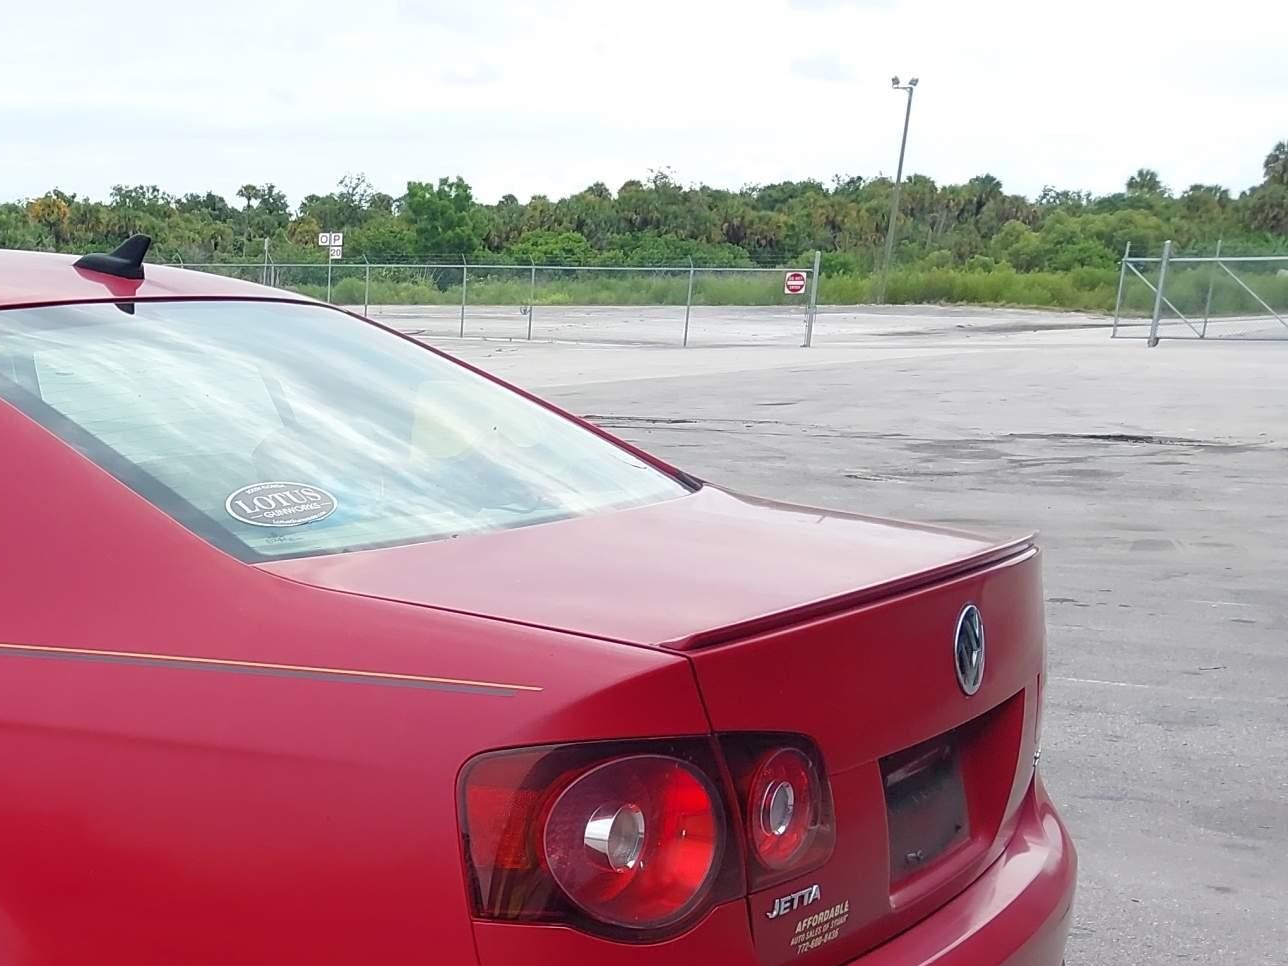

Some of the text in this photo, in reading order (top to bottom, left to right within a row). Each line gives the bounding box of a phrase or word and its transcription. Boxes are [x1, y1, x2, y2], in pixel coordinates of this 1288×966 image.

[333, 234, 341, 244] P
[330, 248, 341, 257] 20
[234, 487, 322, 514] LOTUS
[263, 502, 321, 519] GUNWORKS
[766, 884, 821, 919] JETTA
[795, 899, 849, 934] AFFORDABLE
[790, 933, 806, 946] AUTO
[805, 926, 822, 940] SALES
